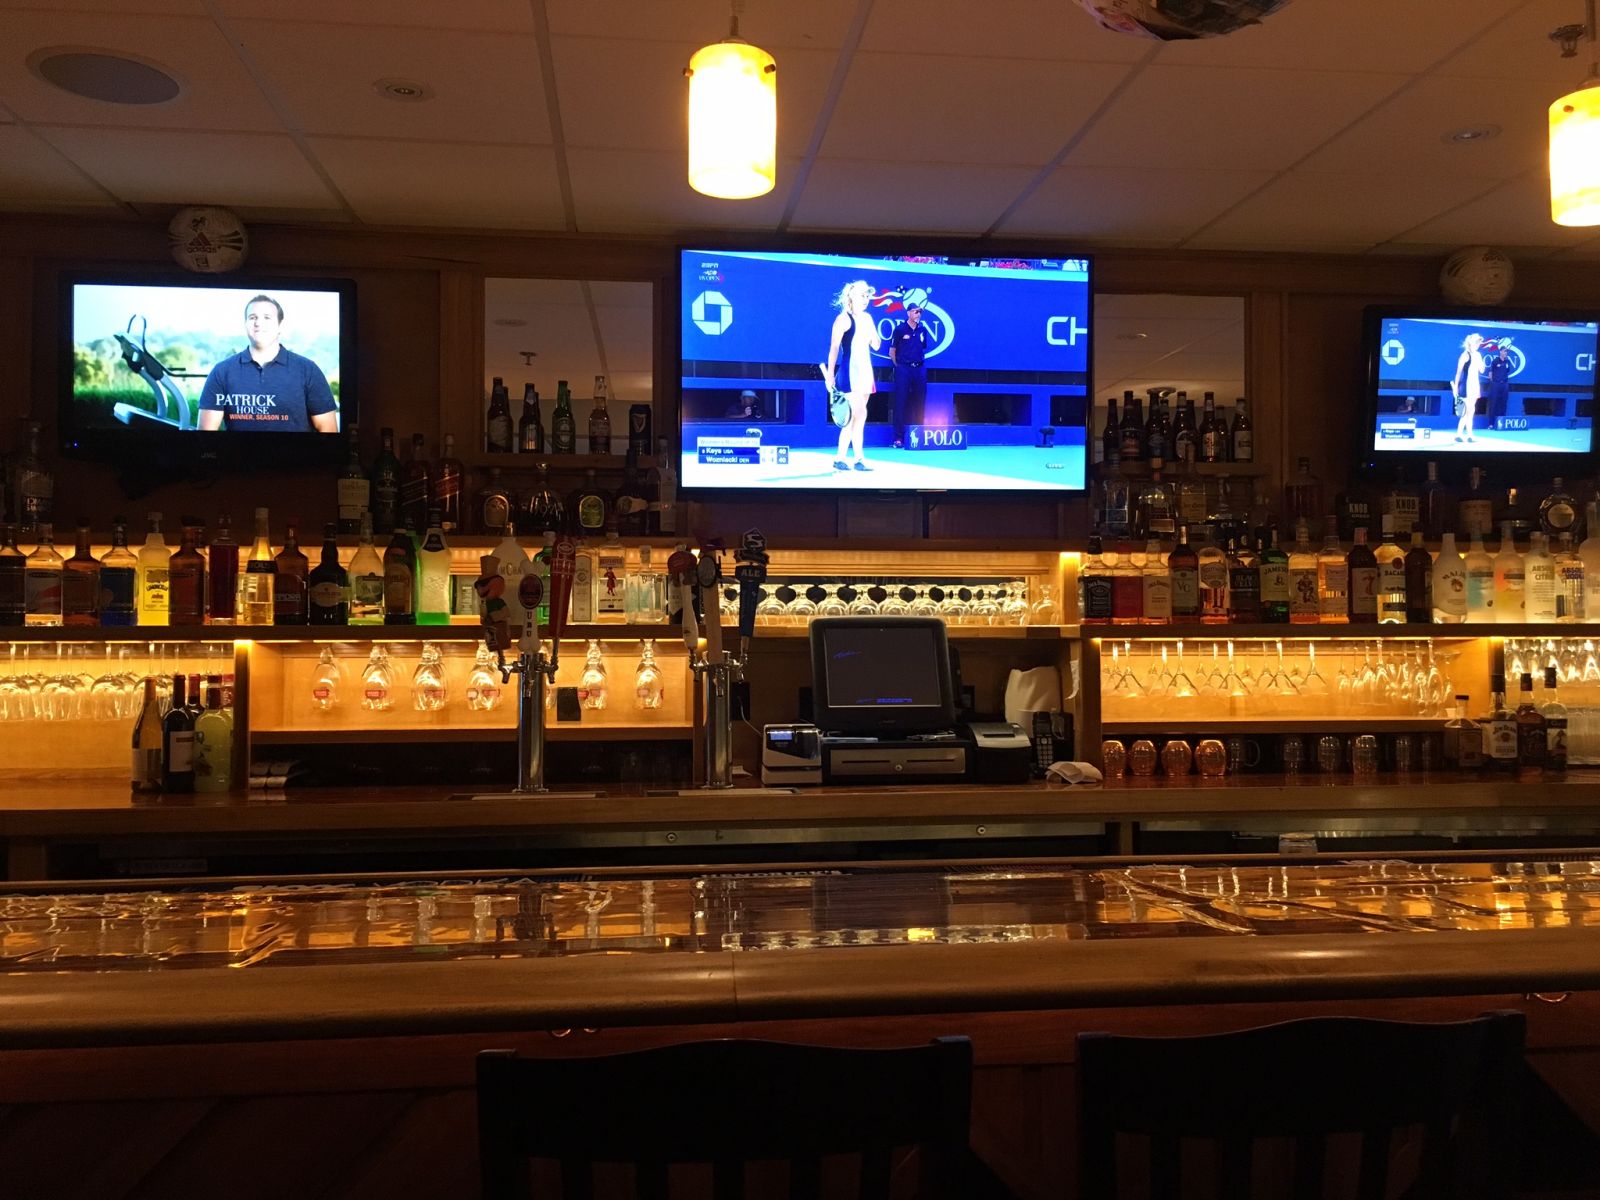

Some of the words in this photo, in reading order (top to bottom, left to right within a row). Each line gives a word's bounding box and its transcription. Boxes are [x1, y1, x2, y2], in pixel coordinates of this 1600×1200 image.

[877, 318, 939, 342] ON
[1046, 316, 1088, 346] CH
[215, 393, 277, 407] PATRICK
[236, 405, 269, 415] HOUSE
[1505, 418, 1527, 429] POLO
[924, 429, 963, 446] POLO
